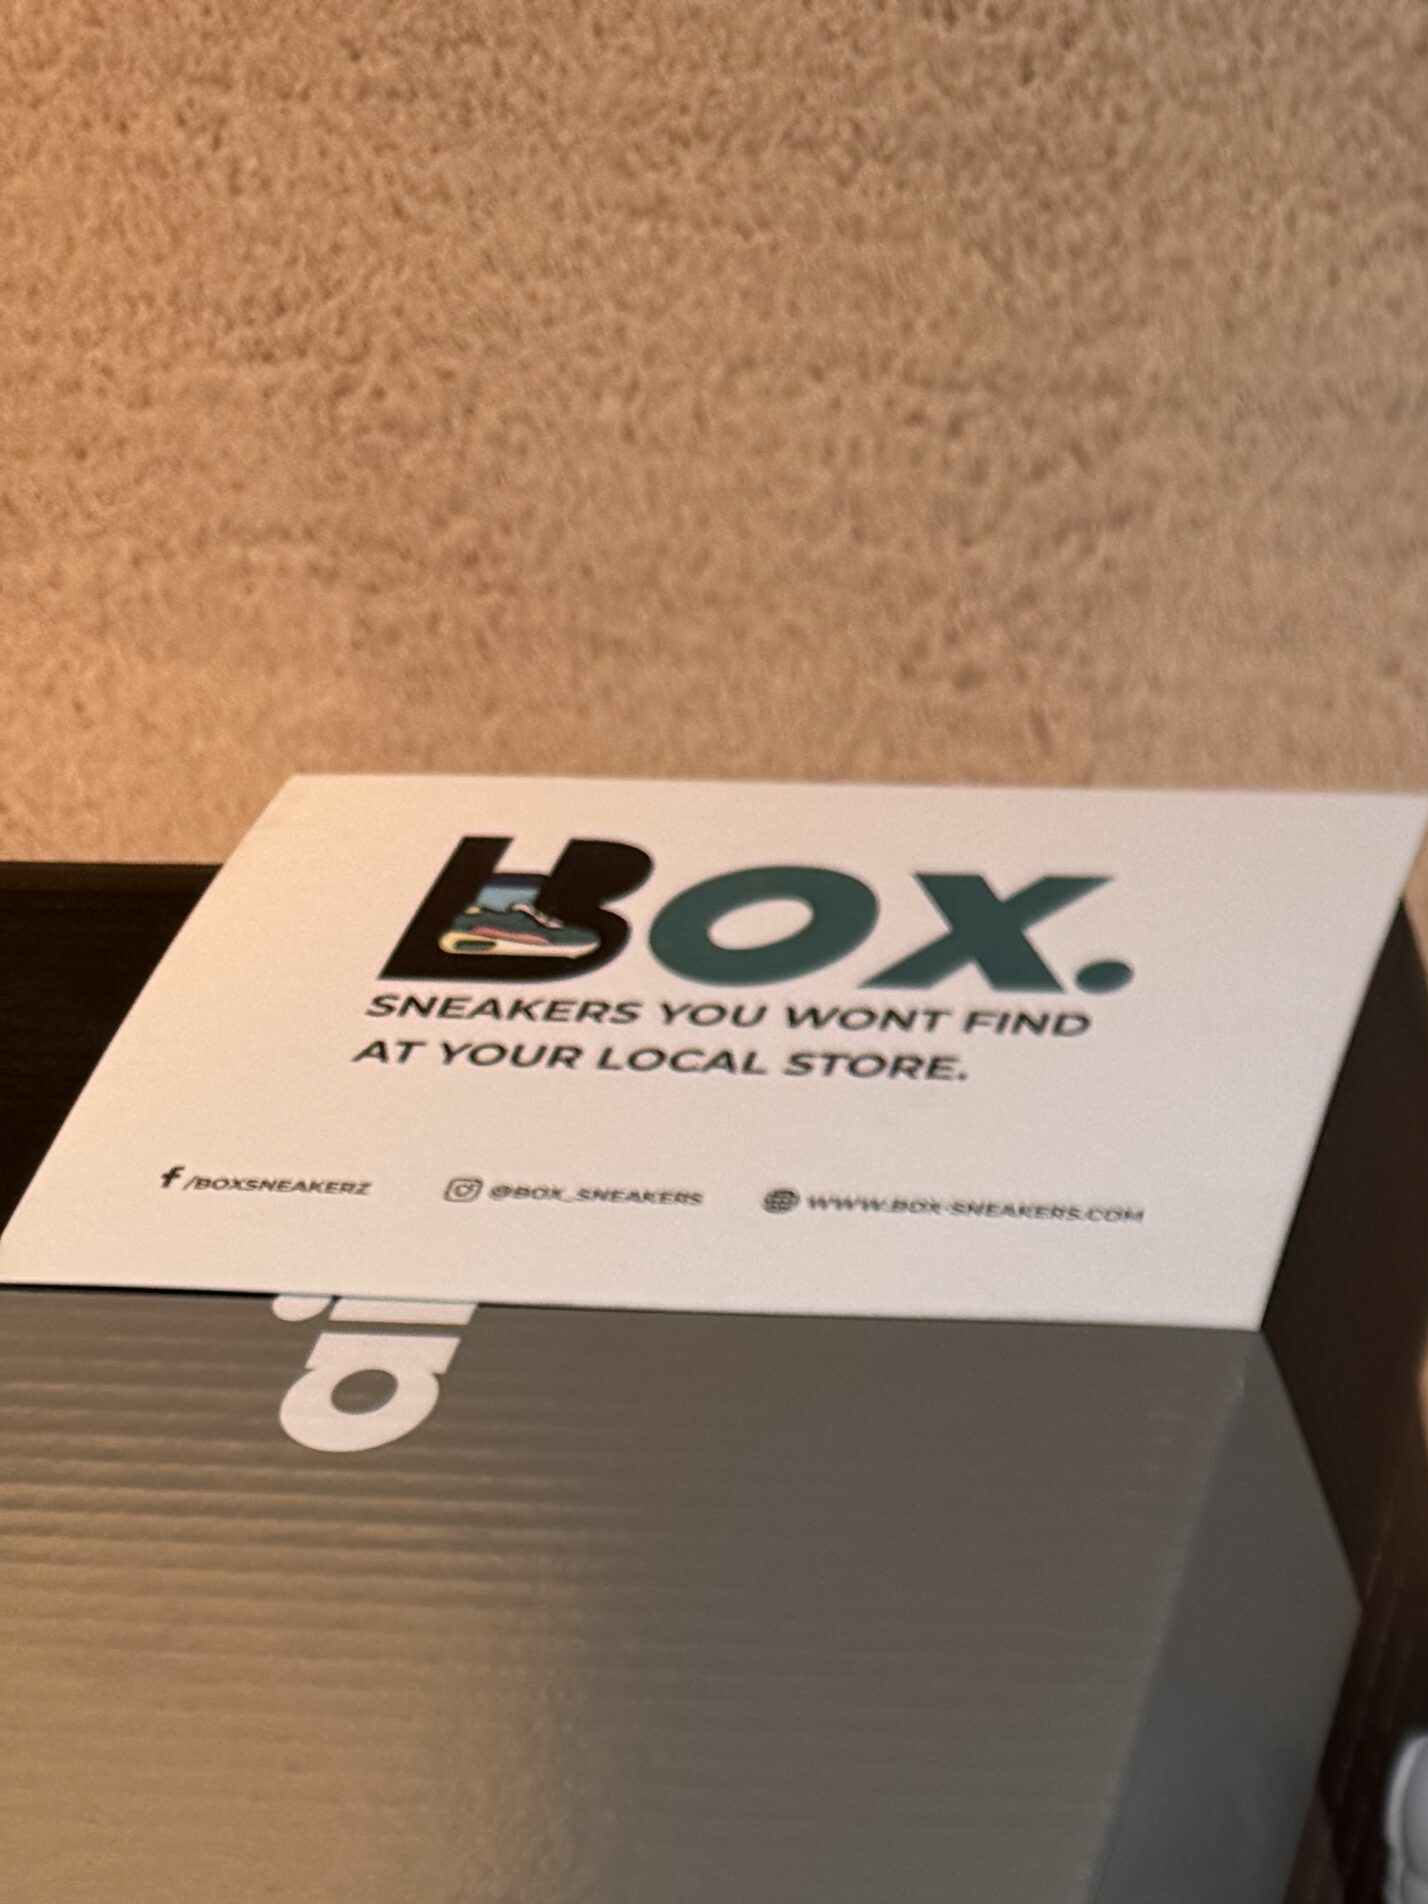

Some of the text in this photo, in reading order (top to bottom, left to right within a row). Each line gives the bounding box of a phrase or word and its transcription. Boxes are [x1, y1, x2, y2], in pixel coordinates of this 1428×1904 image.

[364, 993, 1092, 1038] SNEAKERS YOU WONT FIND
[351, 1039, 969, 1082] AT YOUR LOCAL STORE.
